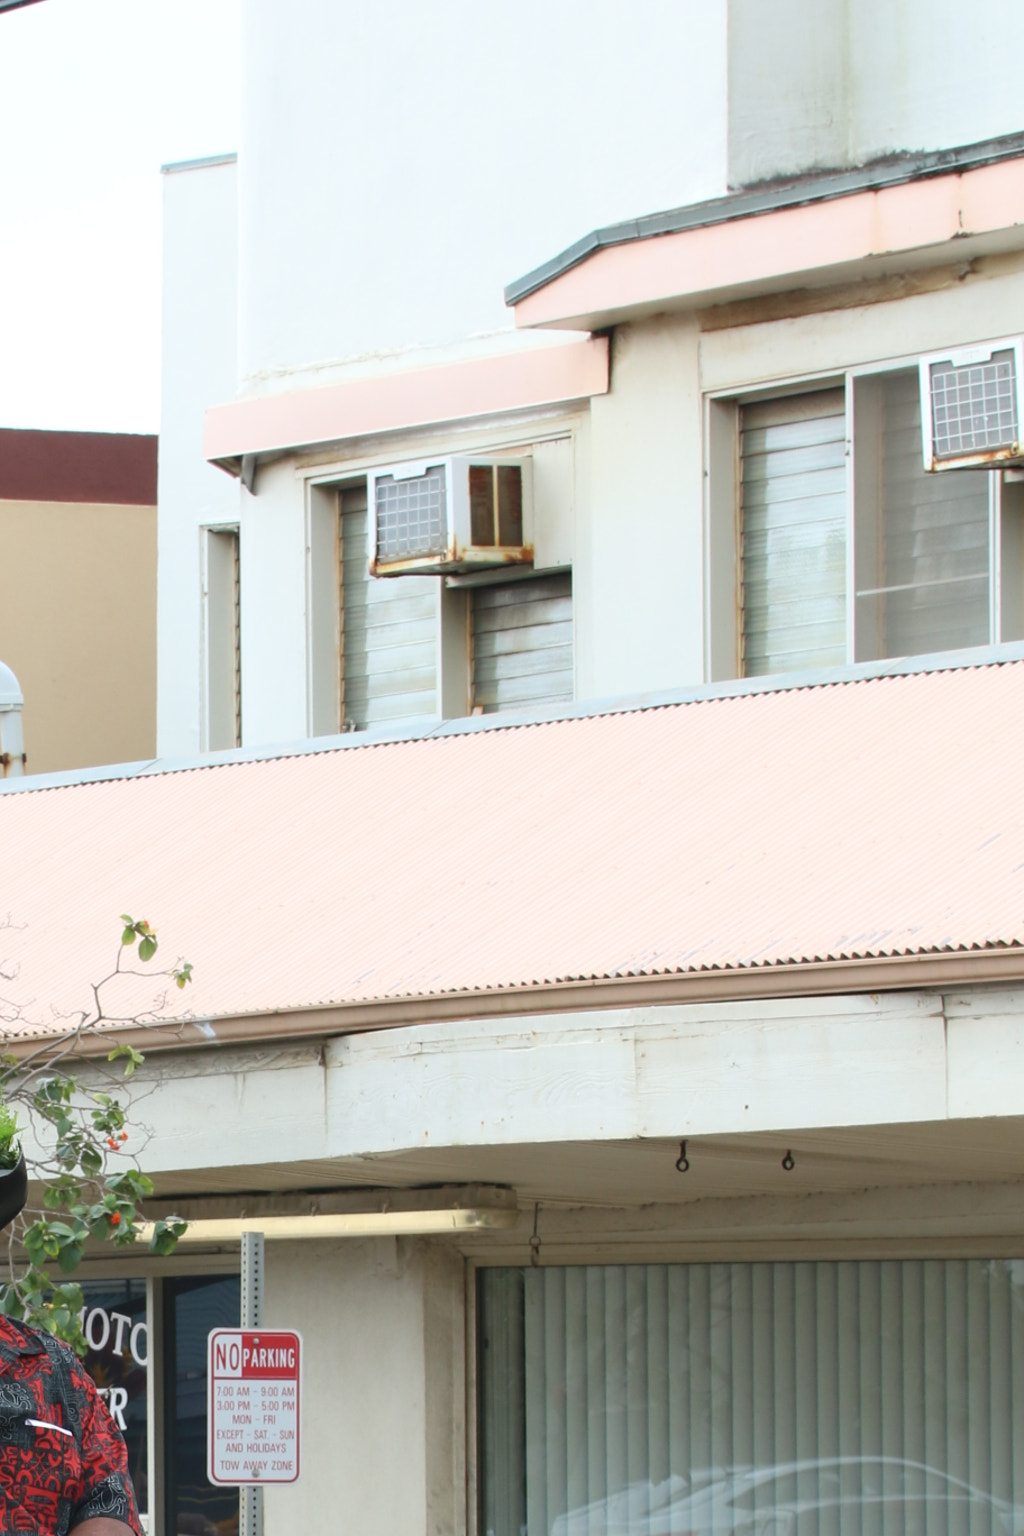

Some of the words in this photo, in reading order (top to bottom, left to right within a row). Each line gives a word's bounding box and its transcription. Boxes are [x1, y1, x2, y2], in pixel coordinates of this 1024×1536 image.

[216, 1342, 240, 1371] NO
[242, 1347, 296, 1369] PARKING
[216, 1386, 234, 1397] 7:00
[236, 1386, 251, 1397] AM
[260, 1386, 279, 1397] 9:00
[281, 1386, 295, 1397] AM
[216, 1400, 235, 1411] 3:00
[237, 1400, 251, 1411] PM
[261, 1400, 280, 1411] 5:00
[282, 1400, 295, 1411] PM
[232, 1414, 252, 1425] MON
[262, 1414, 276, 1425] FRI
[216, 1429, 244, 1440] EXCEPT
[279, 1429, 295, 1440] SUN
[225, 1443, 244, 1454] AND
[246, 1443, 287, 1454] HOLIDAYS
[220, 1460, 240, 1471] TOW
[243, 1460, 269, 1471] AWAY
[271, 1460, 293, 1471] ZONE
